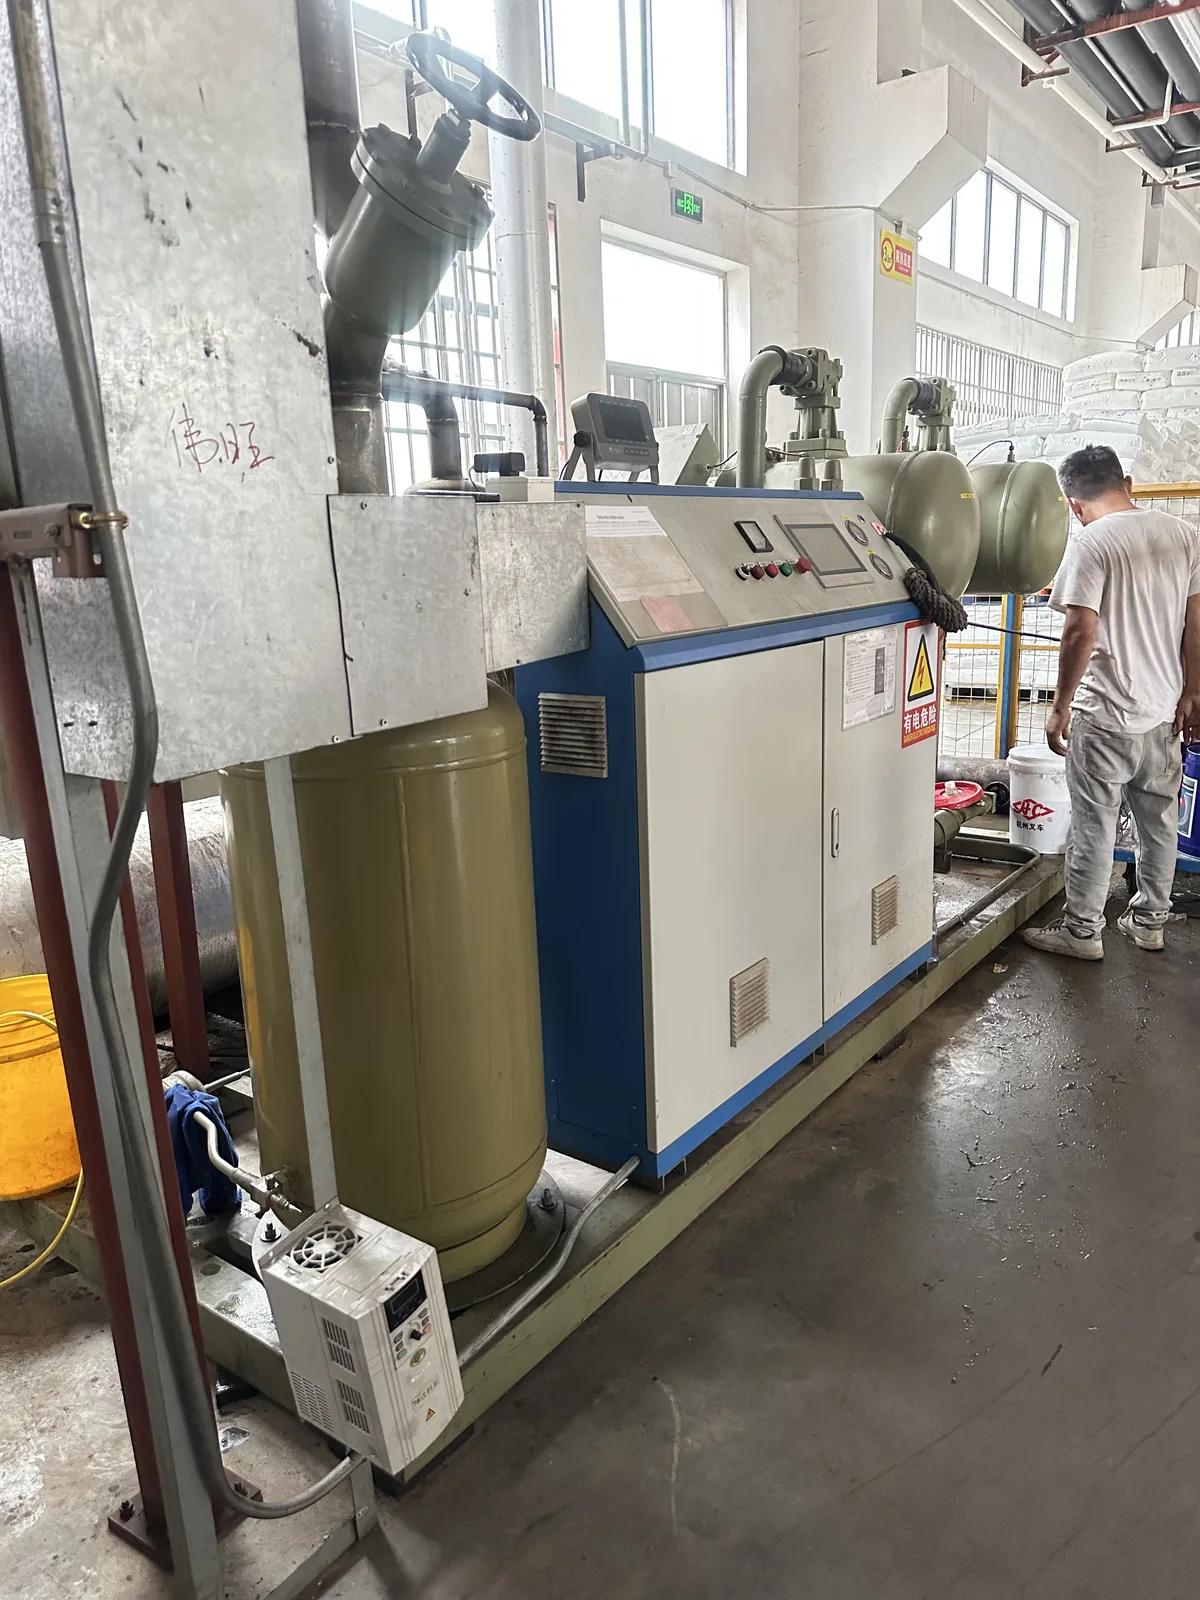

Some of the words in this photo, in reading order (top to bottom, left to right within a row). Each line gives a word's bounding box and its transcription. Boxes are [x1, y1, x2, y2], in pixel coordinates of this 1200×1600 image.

[903, 704, 937, 734] 有电危险
[1016, 820, 1045, 832] 杭州叉车
